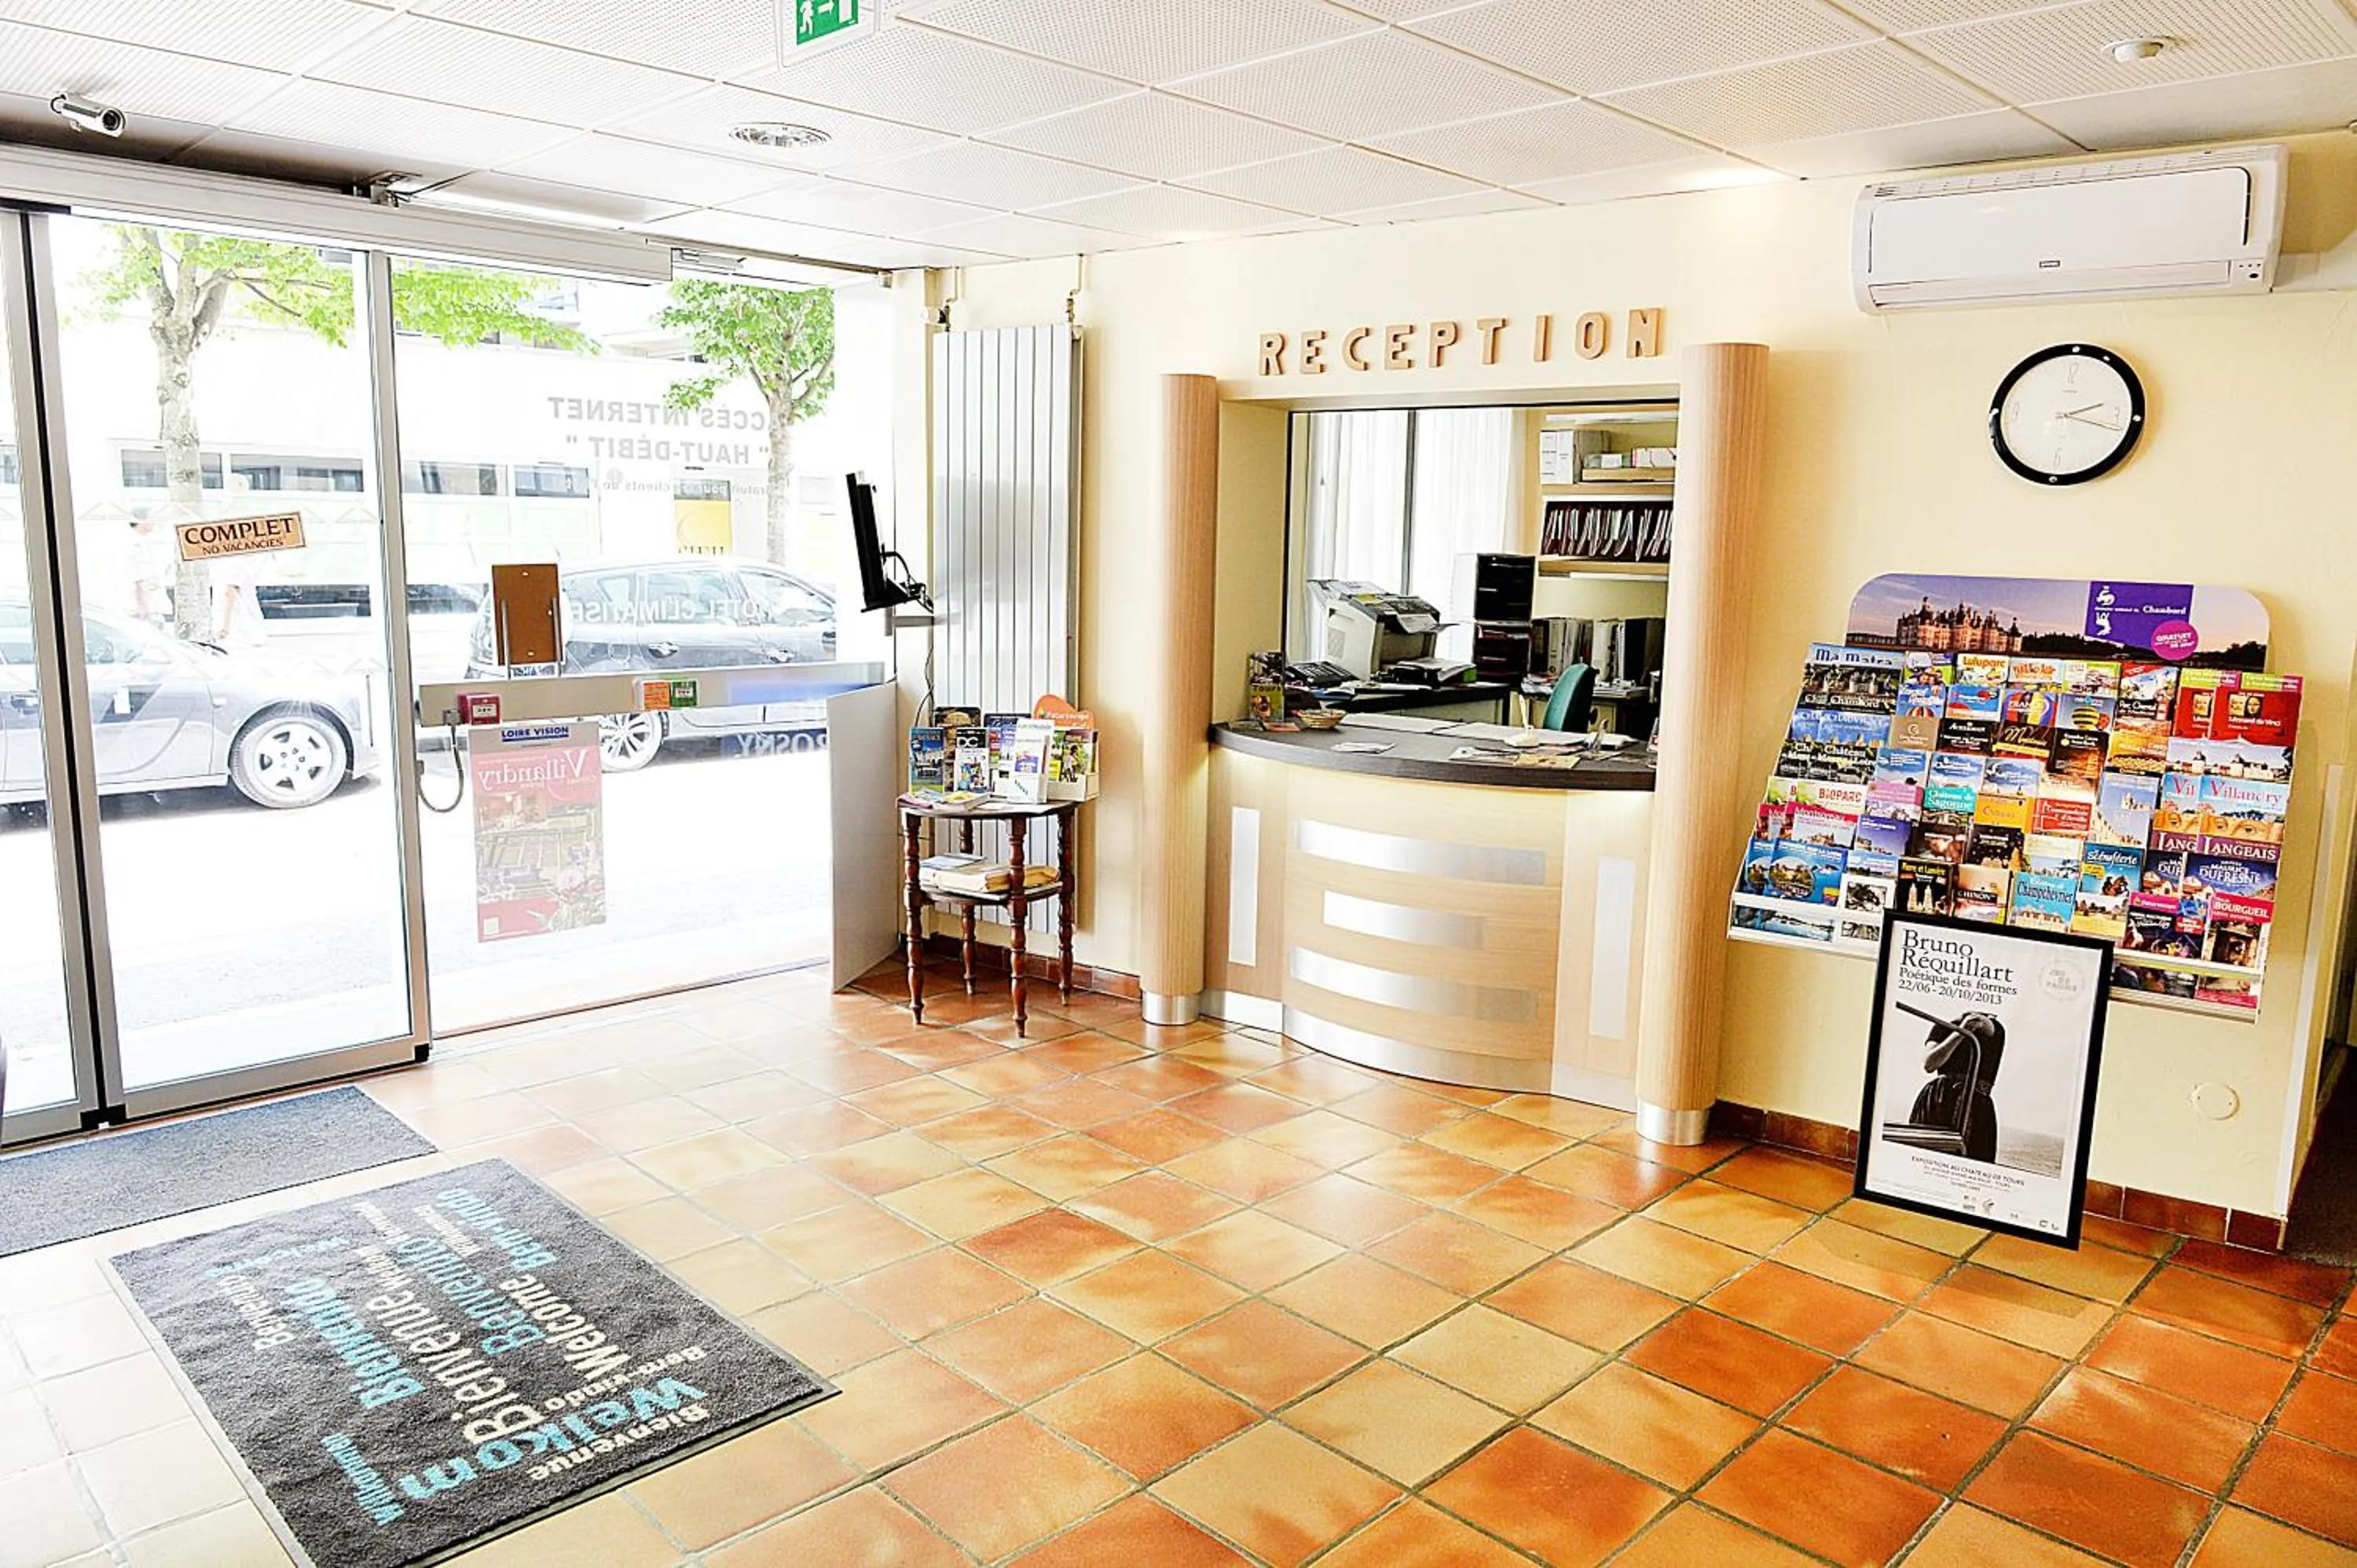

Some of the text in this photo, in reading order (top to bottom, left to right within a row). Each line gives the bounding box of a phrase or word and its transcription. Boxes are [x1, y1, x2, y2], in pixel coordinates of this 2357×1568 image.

[1259, 307, 1662, 376] RECEPTION
[184, 518, 294, 544] COMPLET
[202, 539, 284, 555] NO VACANCIES
[2143, 604, 2187, 615] Chambord
[501, 726, 570, 738] LOIRE VISION
[2210, 779, 2283, 806] Villandry
[2203, 835, 2277, 861] LANGEAIS
[2213, 901, 2270, 919] BOURGUEIL
[1901, 929, 1974, 957] Bruno
[1898, 966, 2018, 995] Poétique des formes
[1901, 946, 2015, 983] Réquillart
[1897, 978, 1930, 995] 22/06
[1939, 987, 2003, 1005] 20/10/2013
[435, 1187, 558, 1272] Bem-vindo
[396, 1236, 546, 1355] Benvenuto
[279, 1276, 427, 1410] Bienvenido
[498, 1273, 631, 1382] Welcome
[365, 1289, 547, 1445] Bienvenue
[544, 1344, 708, 1412] Bem-vindo
[398, 1375, 708, 1501] Welkom
[525, 1402, 709, 1482] Bienvenue
[319, 1431, 405, 1527] Willkommen
